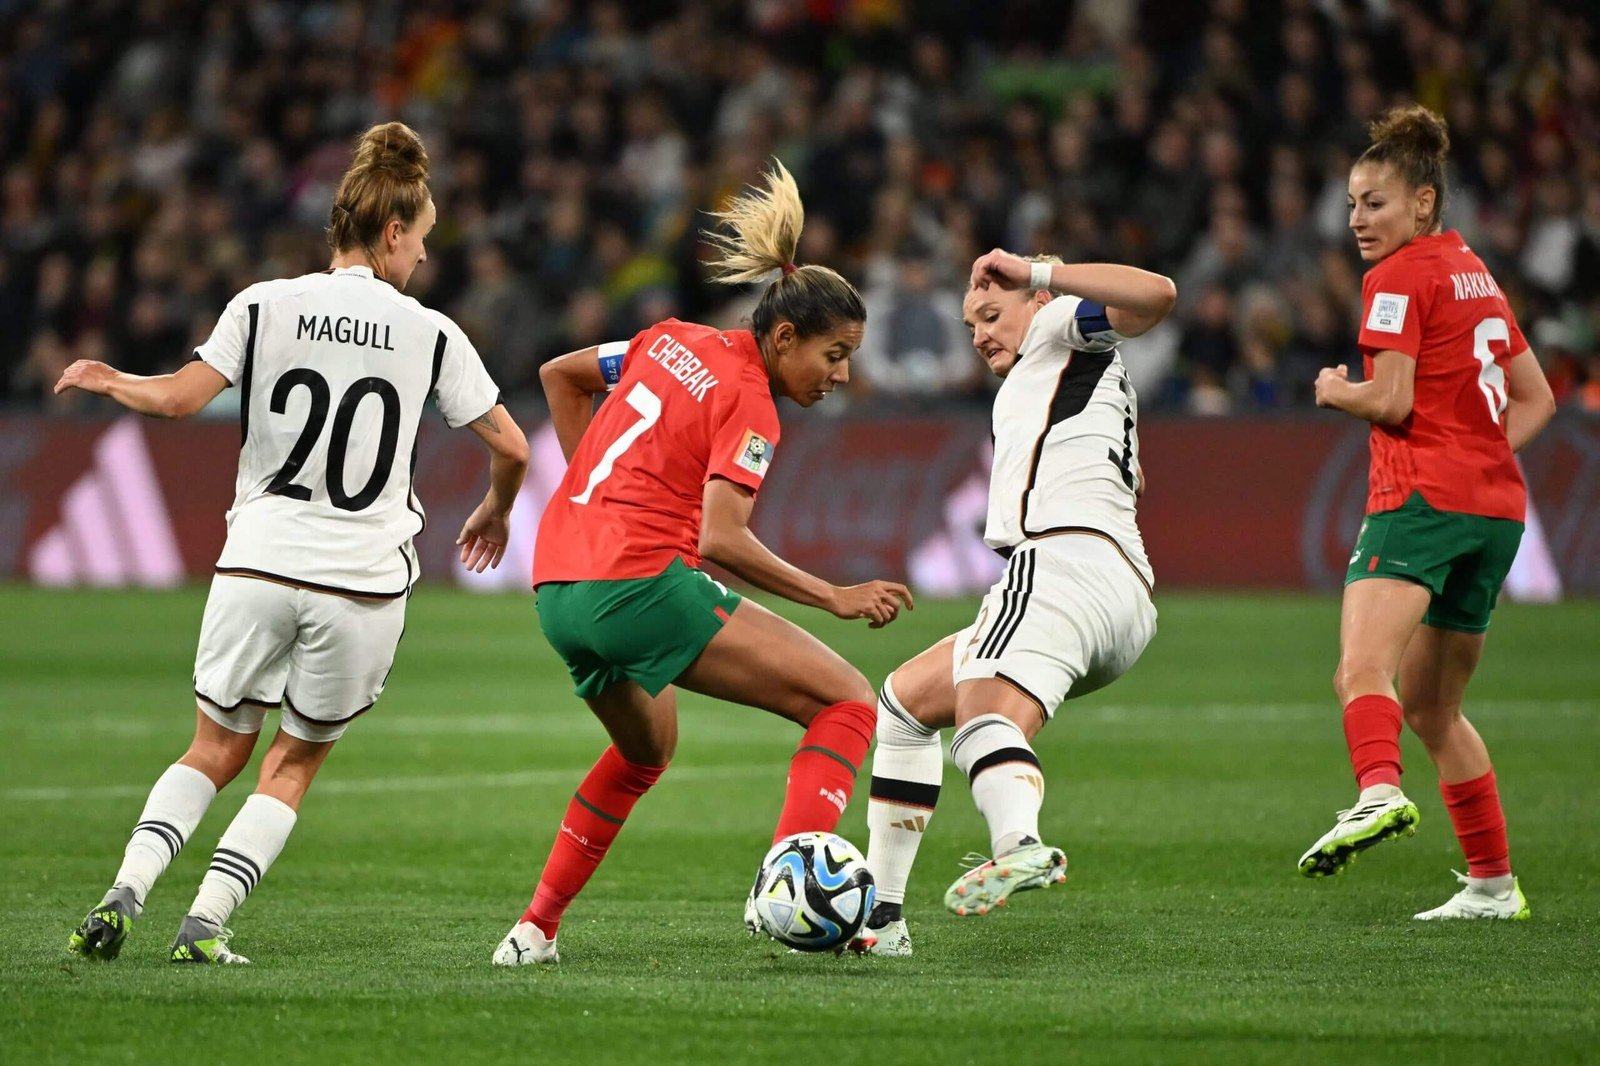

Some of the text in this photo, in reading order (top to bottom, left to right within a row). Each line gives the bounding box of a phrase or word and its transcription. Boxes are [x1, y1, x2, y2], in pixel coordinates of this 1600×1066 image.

[296, 314, 395, 351] MAGULL
[646, 333, 719, 403] CHEBBAK
[1473, 317, 1511, 426] 6
[262, 367, 401, 512] 20
[568, 380, 662, 505] 7
